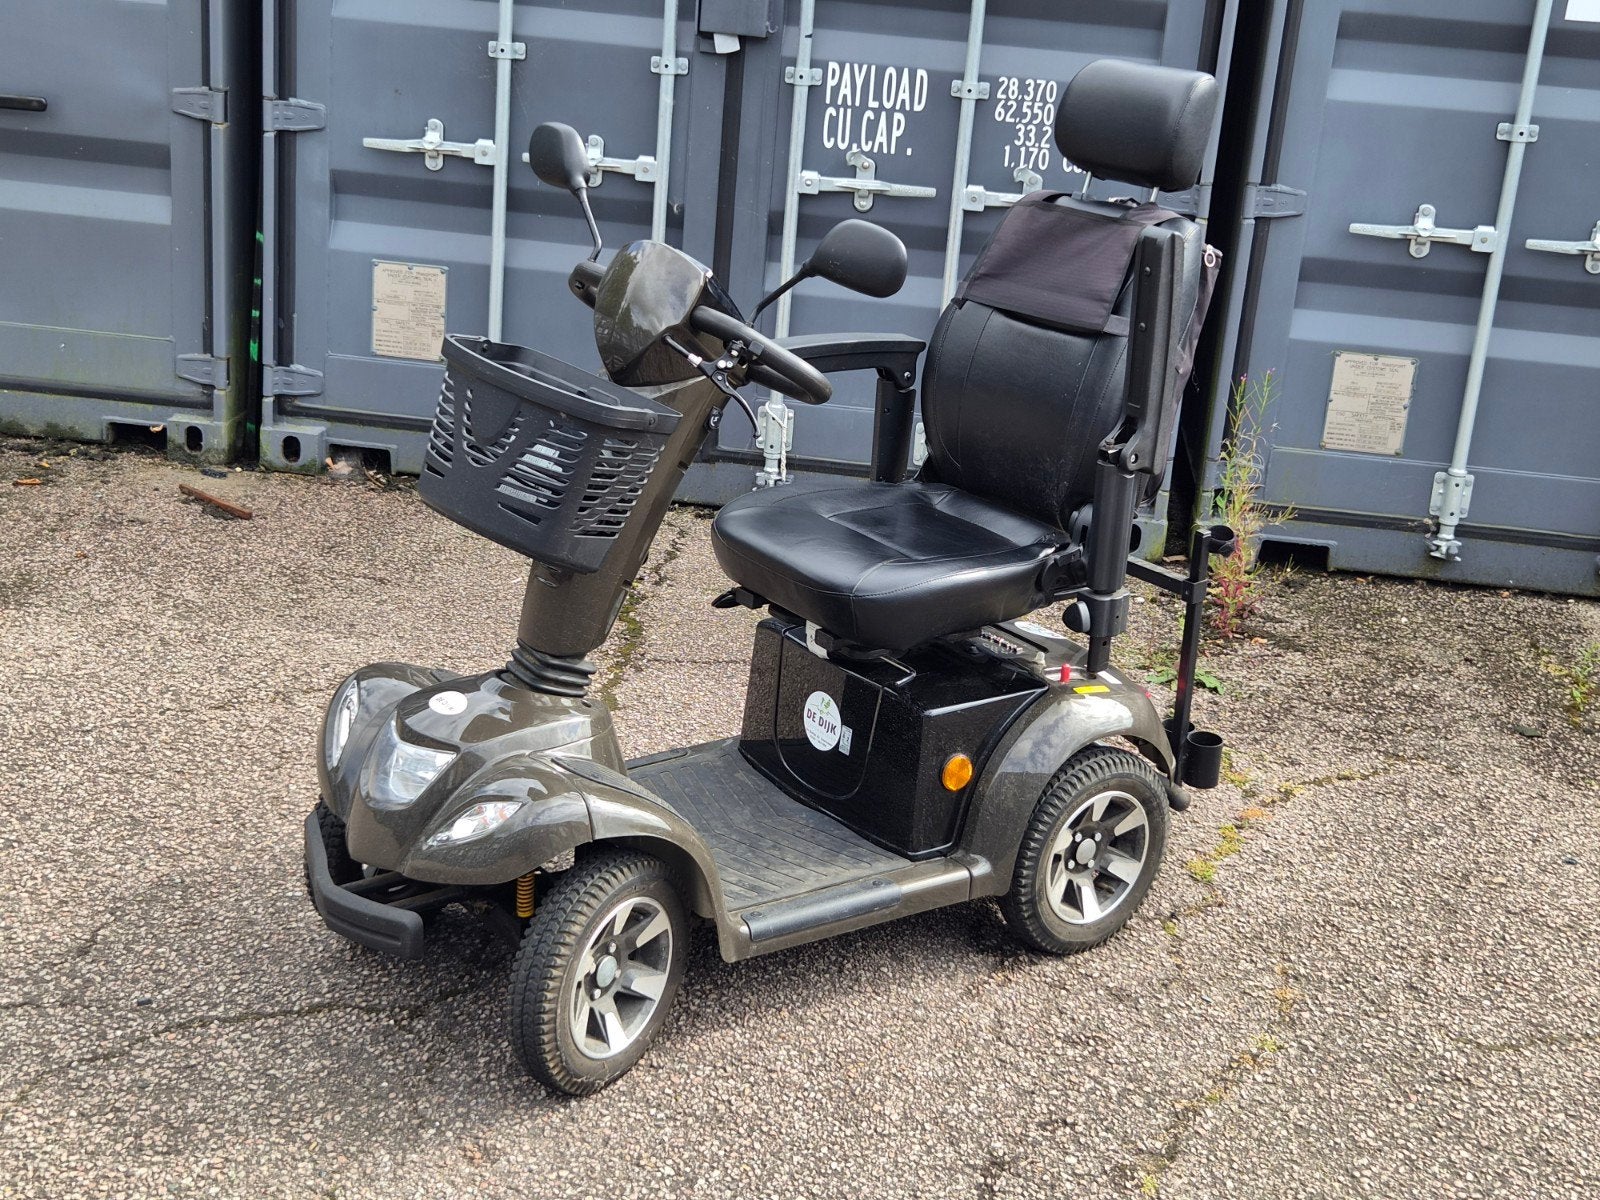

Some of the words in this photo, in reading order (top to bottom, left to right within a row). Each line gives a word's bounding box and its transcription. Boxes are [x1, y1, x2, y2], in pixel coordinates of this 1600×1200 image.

[825, 61, 928, 112] PAYLOAD
[1013, 123, 1052, 149] 33.2
[806, 708, 817, 723] DE
[818, 715, 837, 735] DIJK
